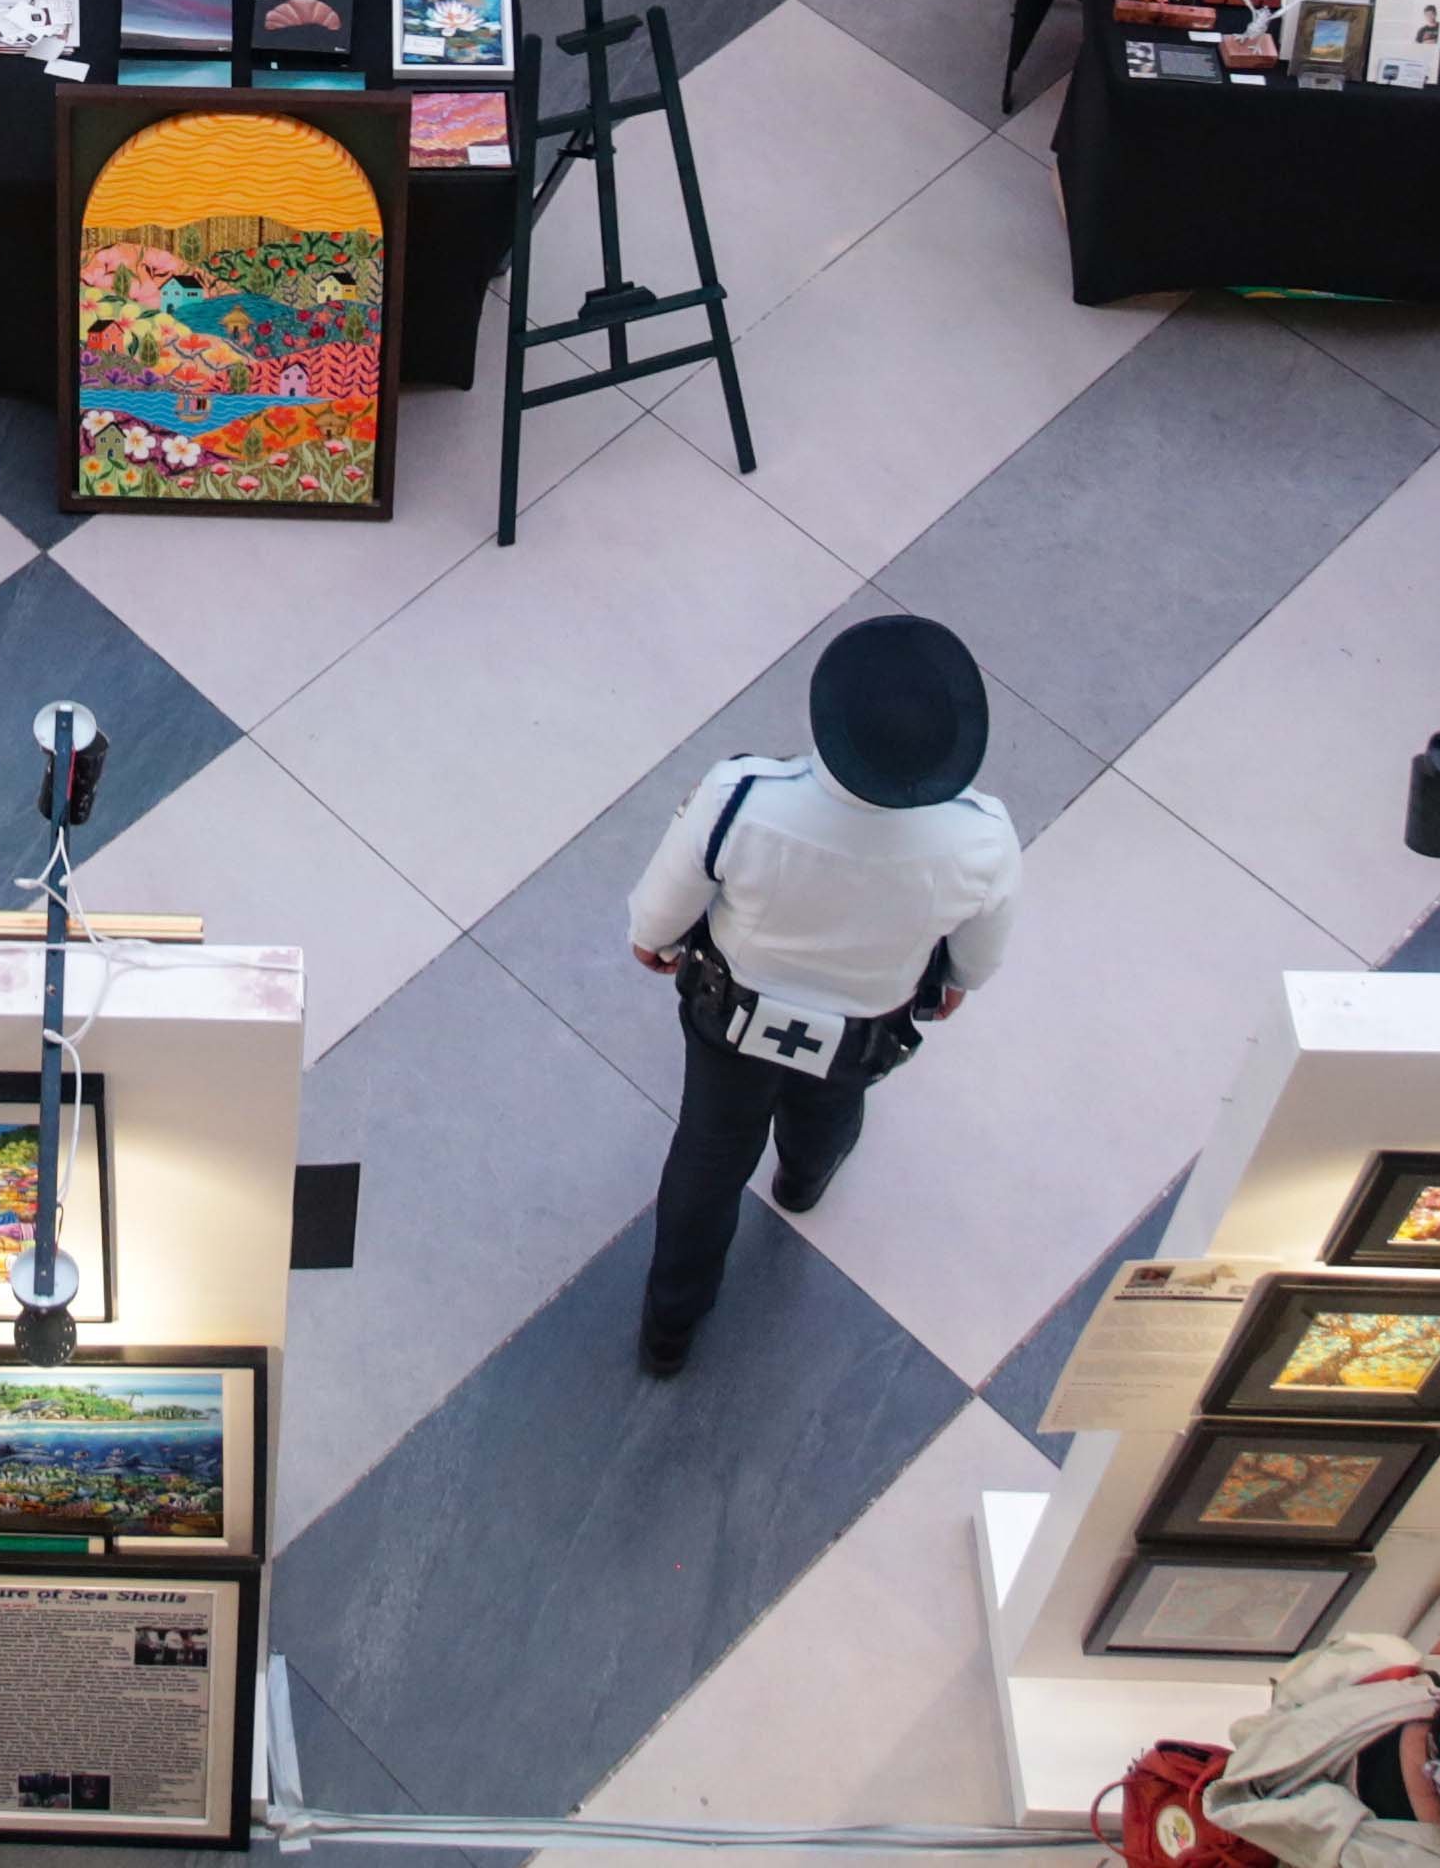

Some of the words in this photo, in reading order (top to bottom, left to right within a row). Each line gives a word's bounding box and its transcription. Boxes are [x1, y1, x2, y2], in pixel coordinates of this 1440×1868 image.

[37, 1589, 62, 1600] of
[69, 1589, 108, 1601] Sea
[116, 1591, 187, 1604] Shells
